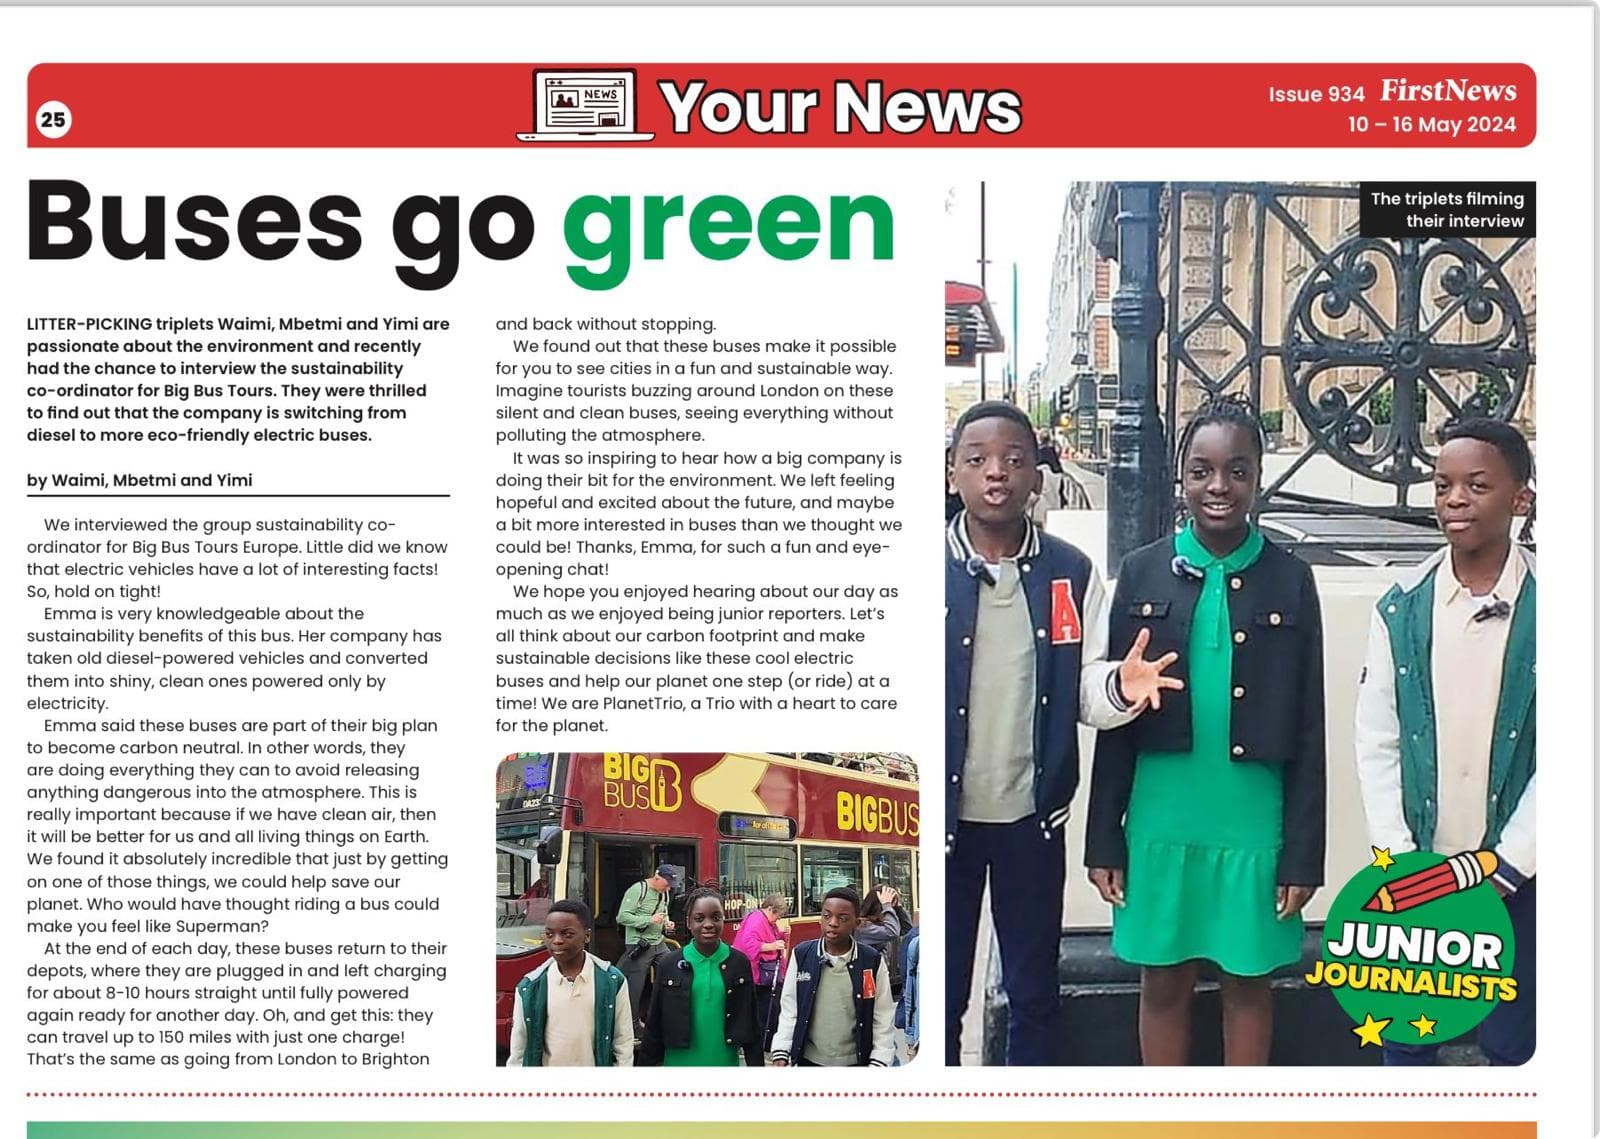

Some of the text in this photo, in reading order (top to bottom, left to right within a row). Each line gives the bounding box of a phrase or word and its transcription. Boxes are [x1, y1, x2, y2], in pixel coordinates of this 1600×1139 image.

[584, 89, 617, 99] NEWS
[1270, 86, 1365, 102] Issue 934
[1381, 78, 1516, 101] FirstNews
[657, 80, 1022, 134] Your News
[41, 111, 66, 128] 25
[1349, 116, 1368, 132] 10
[1393, 116, 1412, 132] 16
[1419, 117, 1462, 137] May
[1468, 116, 1516, 132] 2024
[29, 179, 893, 291] Buses go green
[28, 317, 449, 334] LITTER-PICKING triplets Waimi, Mbetmi and Yimi are
[514, 339, 896, 356] We found out that these buses make it possible
[28, 361, 403, 378] had the chance to interview the sustainability
[27, 384, 426, 401] co-ordinator for Big Bus Tours. They were thrilled
[497, 406, 893, 423] silent and clean buses, seeing everything without
[28, 473, 252, 490] by Waimi, Mbetmi and Yimi
[496, 473, 894, 490] doing their bit for the environment. We left feeling
[45, 607, 364, 624] Emma is very knowledgeable about the
[497, 607, 884, 624] much as we enjoyed being junior reporters. Let’s
[1051, 579, 1082, 645] A
[27, 674, 385, 691] them into shiny, clean ones powered only by
[497, 672, 889, 691] buses and help our planet one step (or ride) at a
[496, 719, 607, 736] for the planet.
[28, 763, 419, 780] are doing everything they can to avoid releasing
[604, 752, 650, 783] BIG
[604, 781, 650, 810] BUS
[28, 897, 439, 914] planet. Who would have thought riding a bus could
[28, 986, 408, 1003] for about 8-10 hours straight until fully powered
[27, 1030, 404, 1047] can travel up to 150 miles with just one charge!
